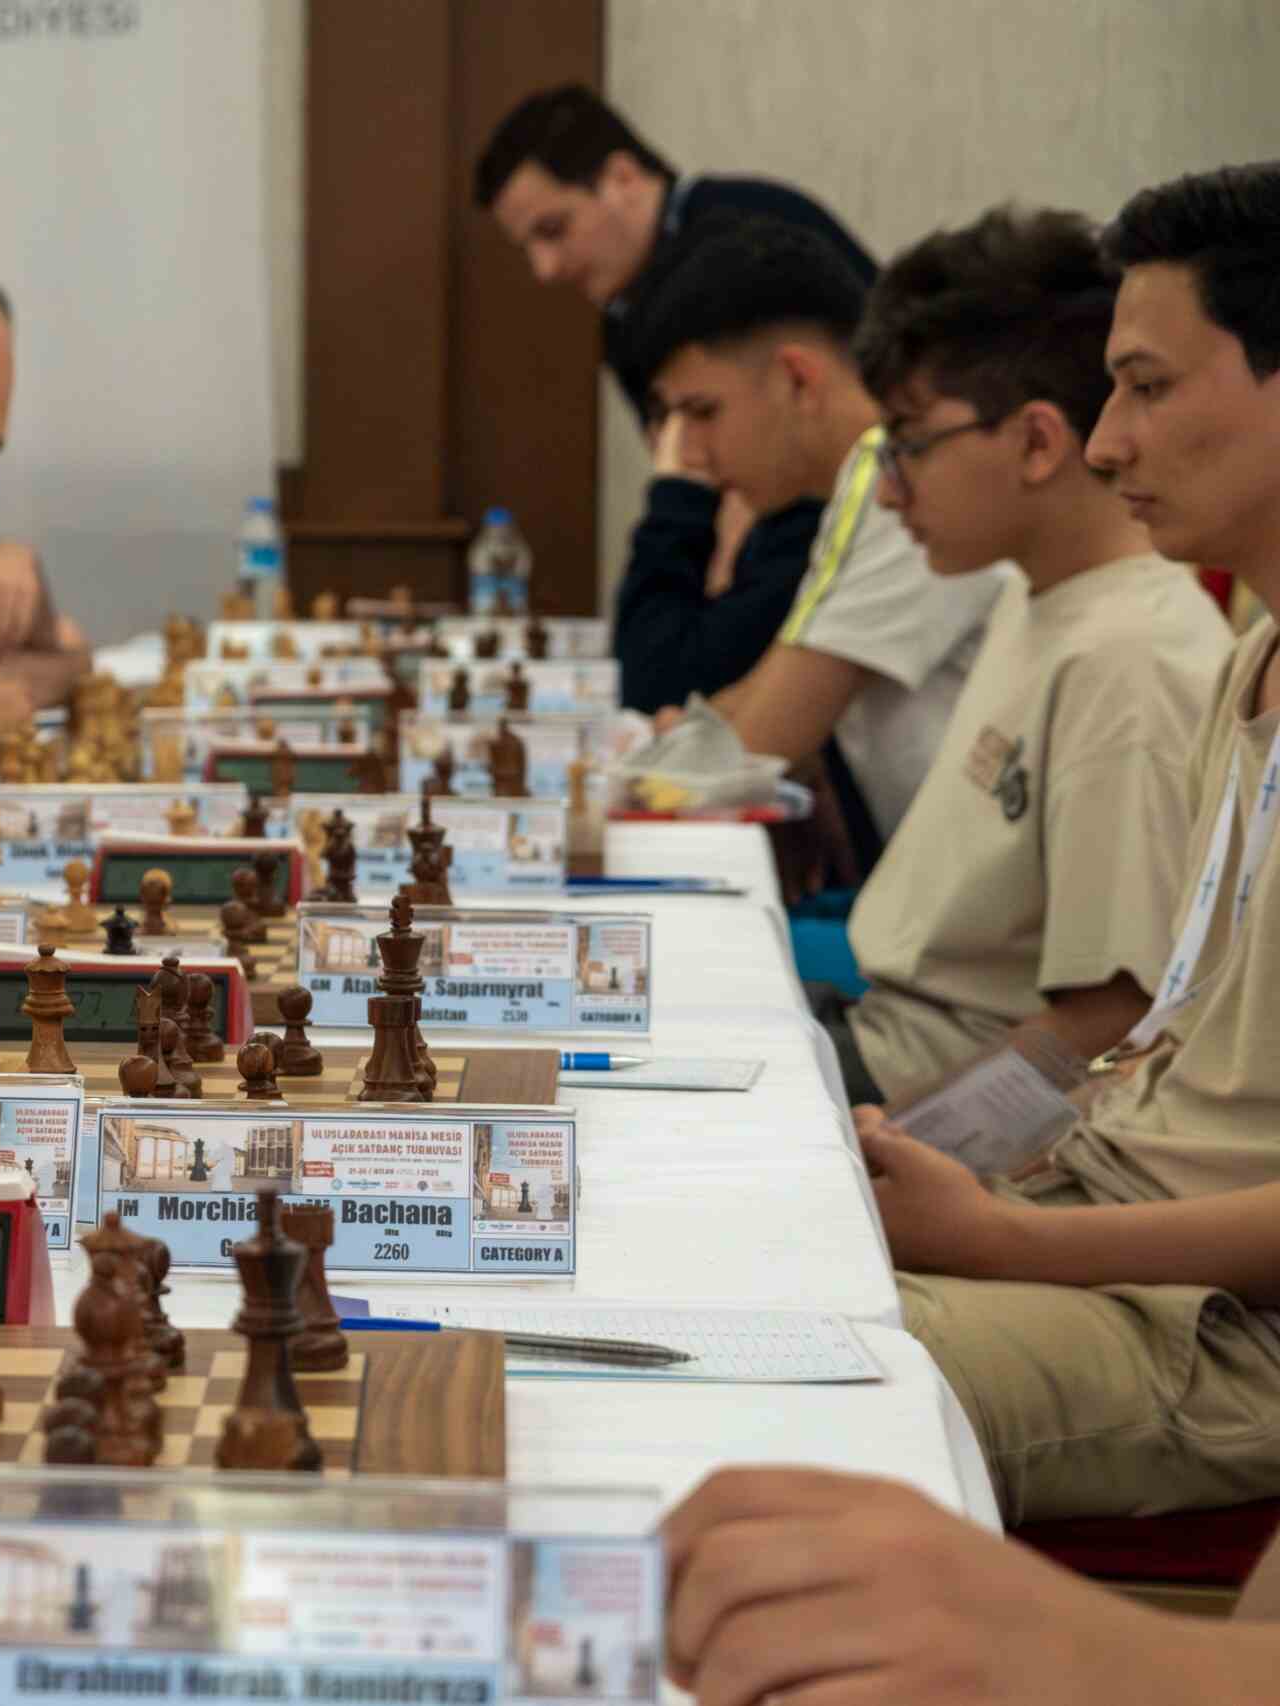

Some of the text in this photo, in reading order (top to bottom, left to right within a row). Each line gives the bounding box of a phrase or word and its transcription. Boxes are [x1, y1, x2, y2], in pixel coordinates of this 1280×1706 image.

[435, 978, 543, 999] Saparmyrat
[341, 1199, 453, 1226] Bachana
[374, 1242, 410, 1261] 2260
[480, 1246, 563, 1262] CATEGORY A
